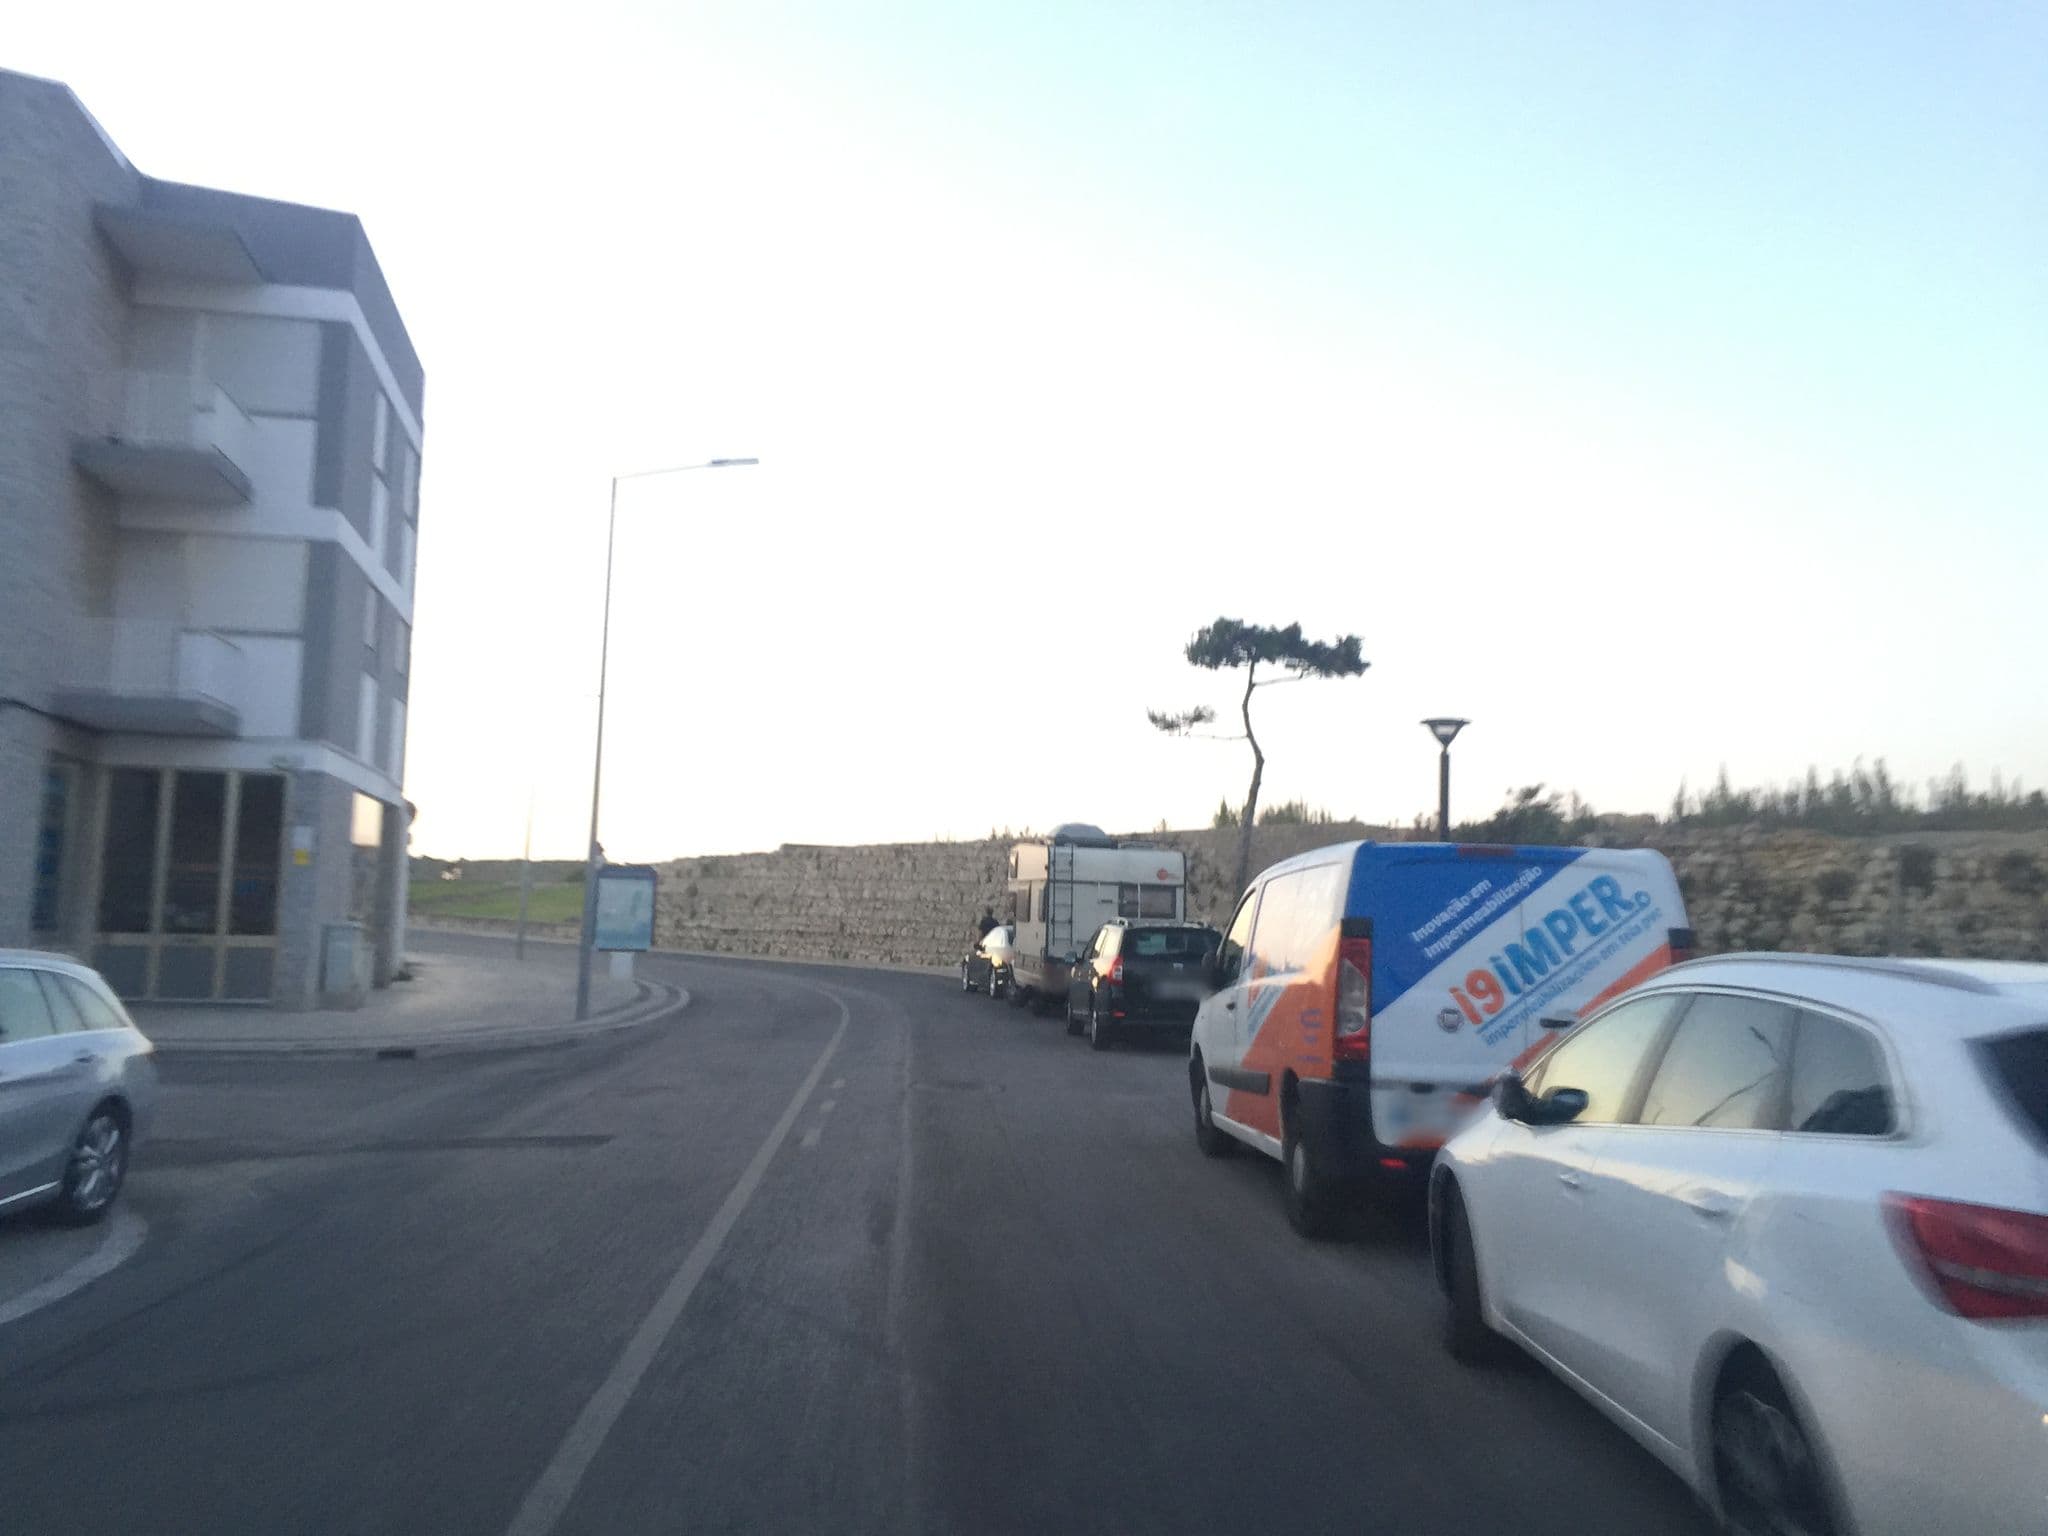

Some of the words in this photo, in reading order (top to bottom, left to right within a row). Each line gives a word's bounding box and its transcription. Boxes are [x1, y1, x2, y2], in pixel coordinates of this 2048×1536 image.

[1411, 898, 1471, 942] Inovação
[1470, 879, 1492, 900] em
[1423, 866, 1542, 958] Impermeabilização
